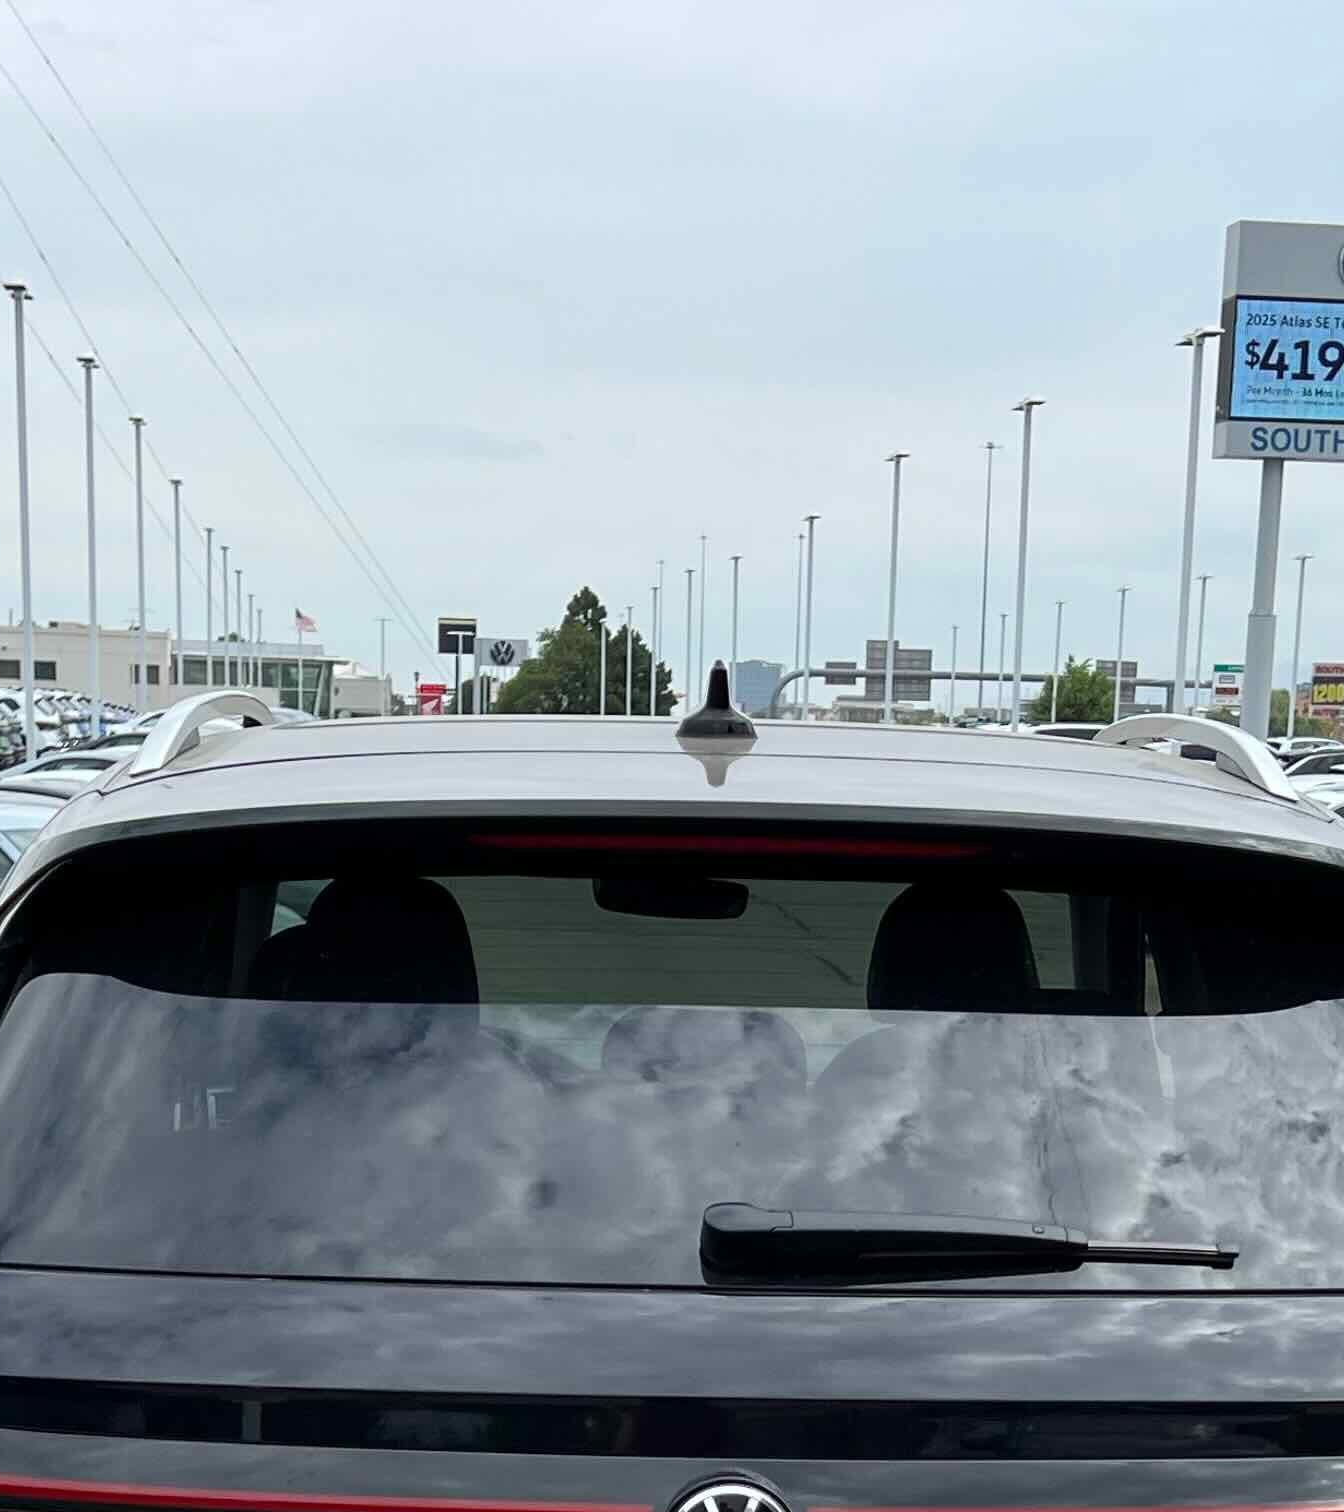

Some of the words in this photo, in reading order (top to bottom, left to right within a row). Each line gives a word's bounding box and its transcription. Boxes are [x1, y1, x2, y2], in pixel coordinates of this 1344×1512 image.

[1246, 313, 1277, 327] 2025
[1280, 315, 1313, 329] Atlas
[1315, 317, 1330, 329] SE
